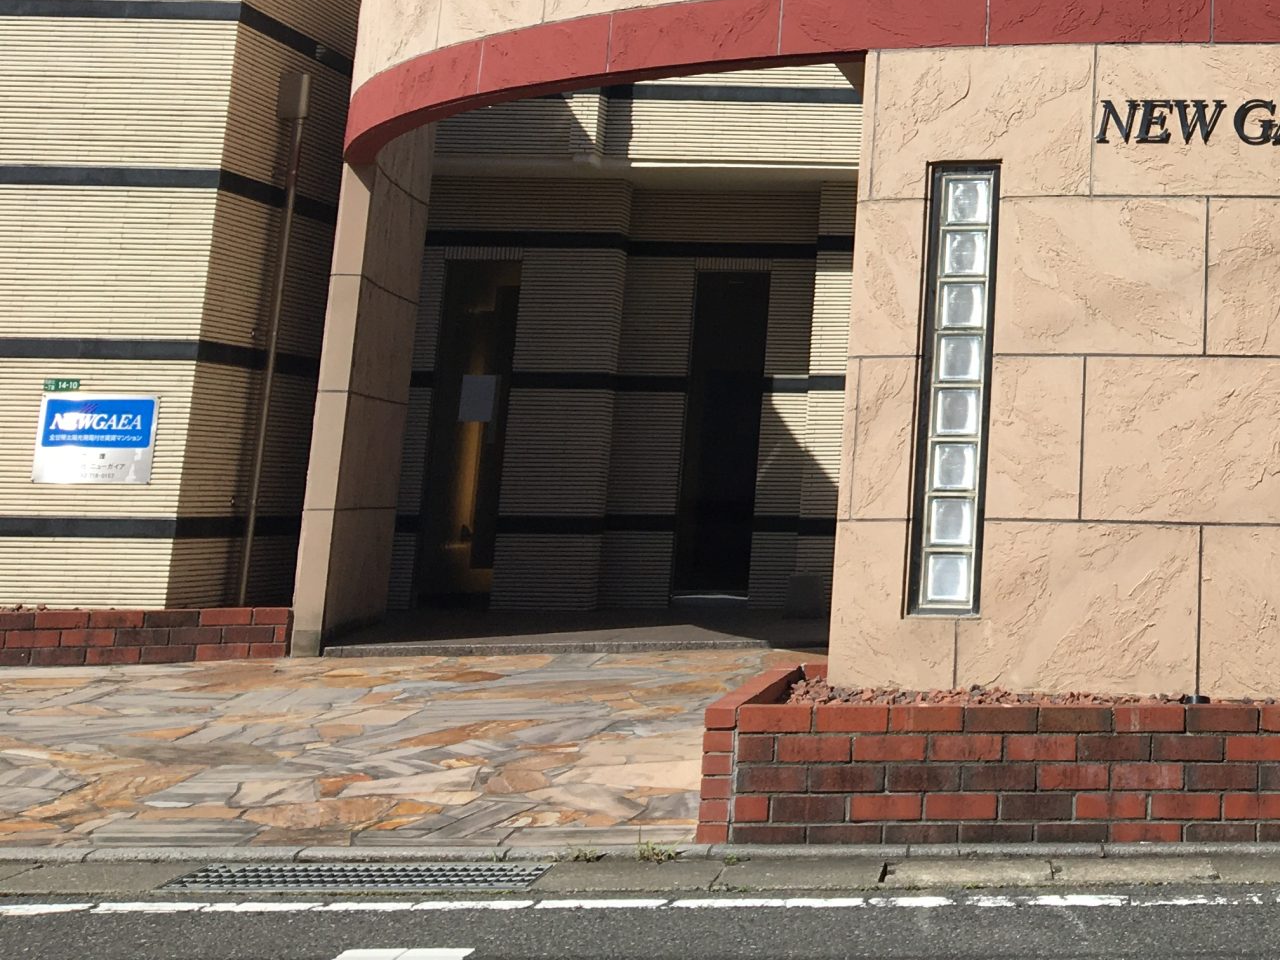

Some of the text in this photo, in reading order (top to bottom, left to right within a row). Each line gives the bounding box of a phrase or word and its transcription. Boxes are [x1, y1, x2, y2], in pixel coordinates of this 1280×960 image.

[1094, 99, 1227, 145] NEW
[58, 381, 78, 389] 14-10
[49, 413, 142, 430] NWGAEA
